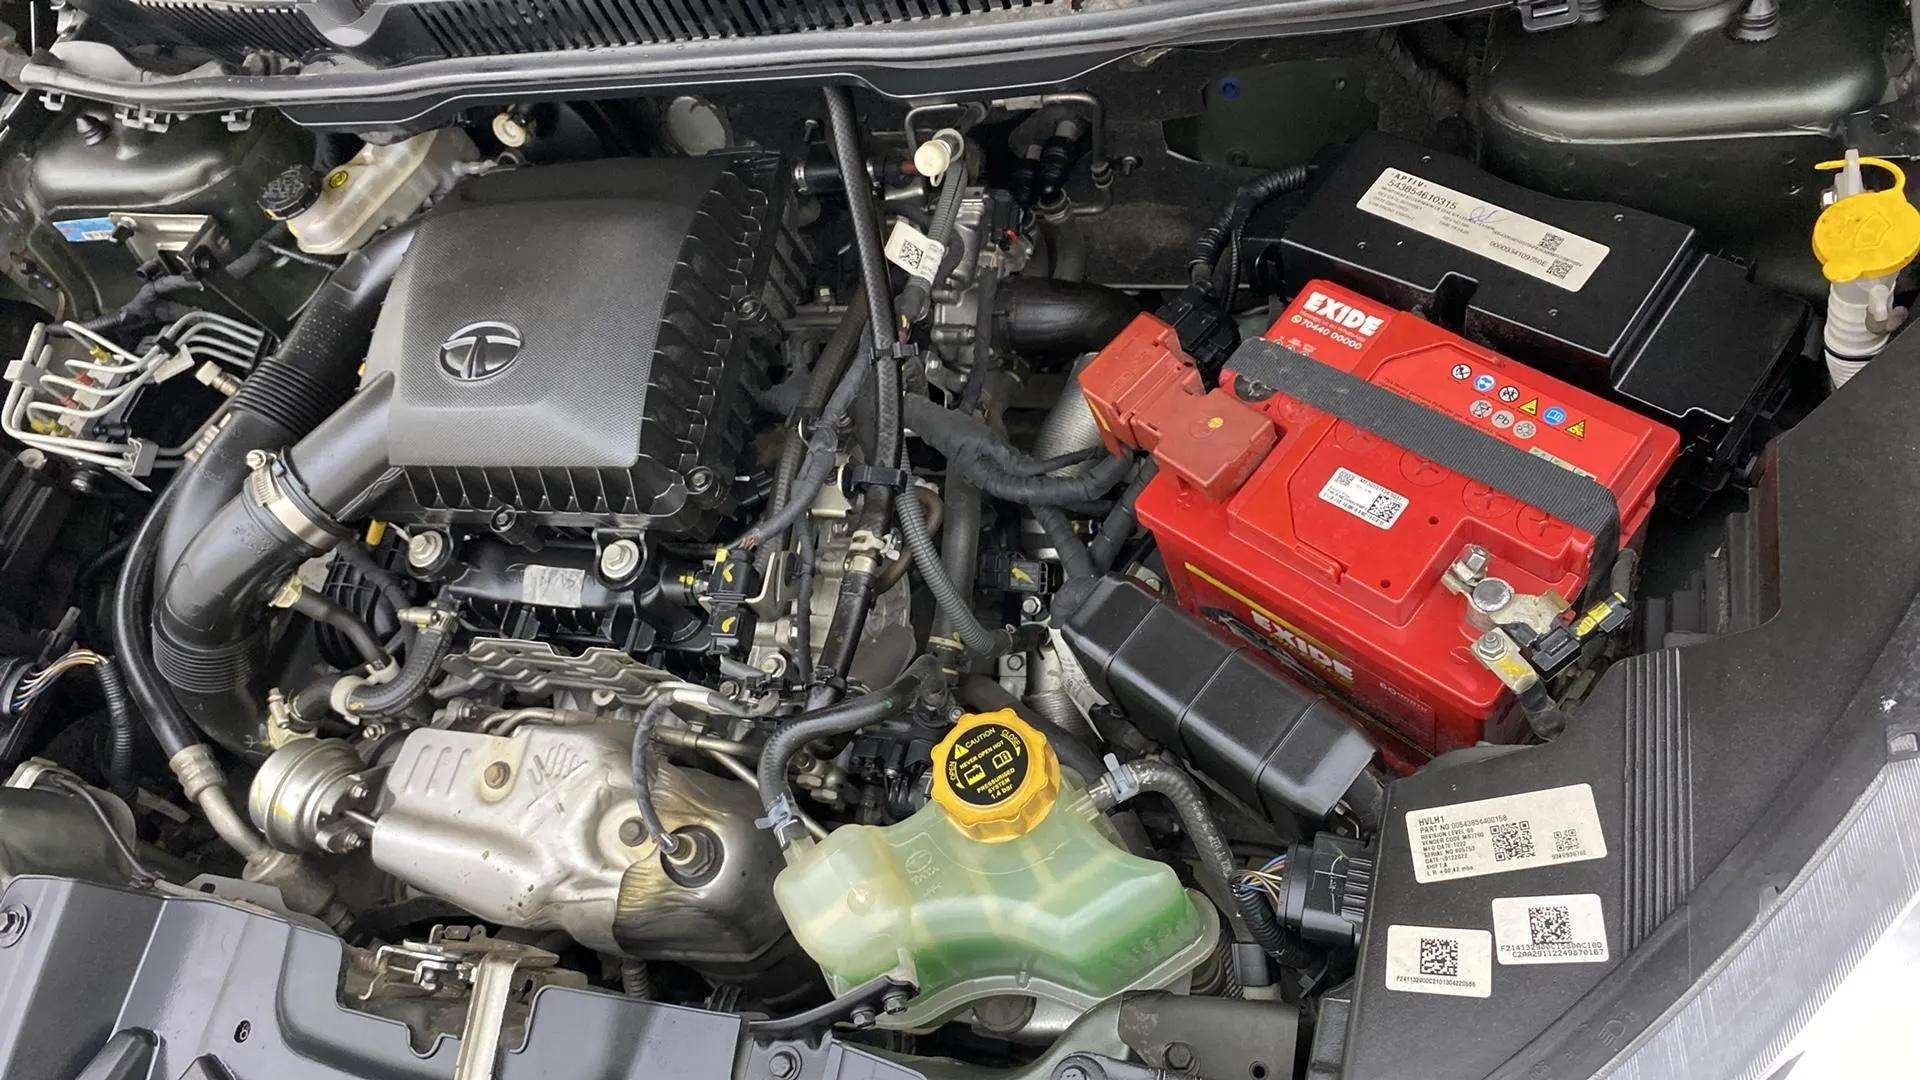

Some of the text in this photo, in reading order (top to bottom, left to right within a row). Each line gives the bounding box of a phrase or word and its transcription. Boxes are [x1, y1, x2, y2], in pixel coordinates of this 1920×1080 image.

[1387, 180, 1457, 210] 543854610315
[1303, 291, 1384, 337] EXIDE
[1302, 318, 1330, 335] 70440
[1330, 332, 1363, 350] 00000
[1495, 414, 1510, 425] Pb
[1251, 610, 1353, 681] EXIDE
[965, 727, 996, 748] CAUTION
[1001, 729, 1021, 747] CLOSE
[960, 740, 1004, 770] NEVER OPEN HOT
[977, 767, 1015, 794] PRESSURISED
[988, 778, 1011, 794] SYSTEM
[991, 785, 1013, 799] 1.4 bar
[1420, 825, 1438, 833] PART
